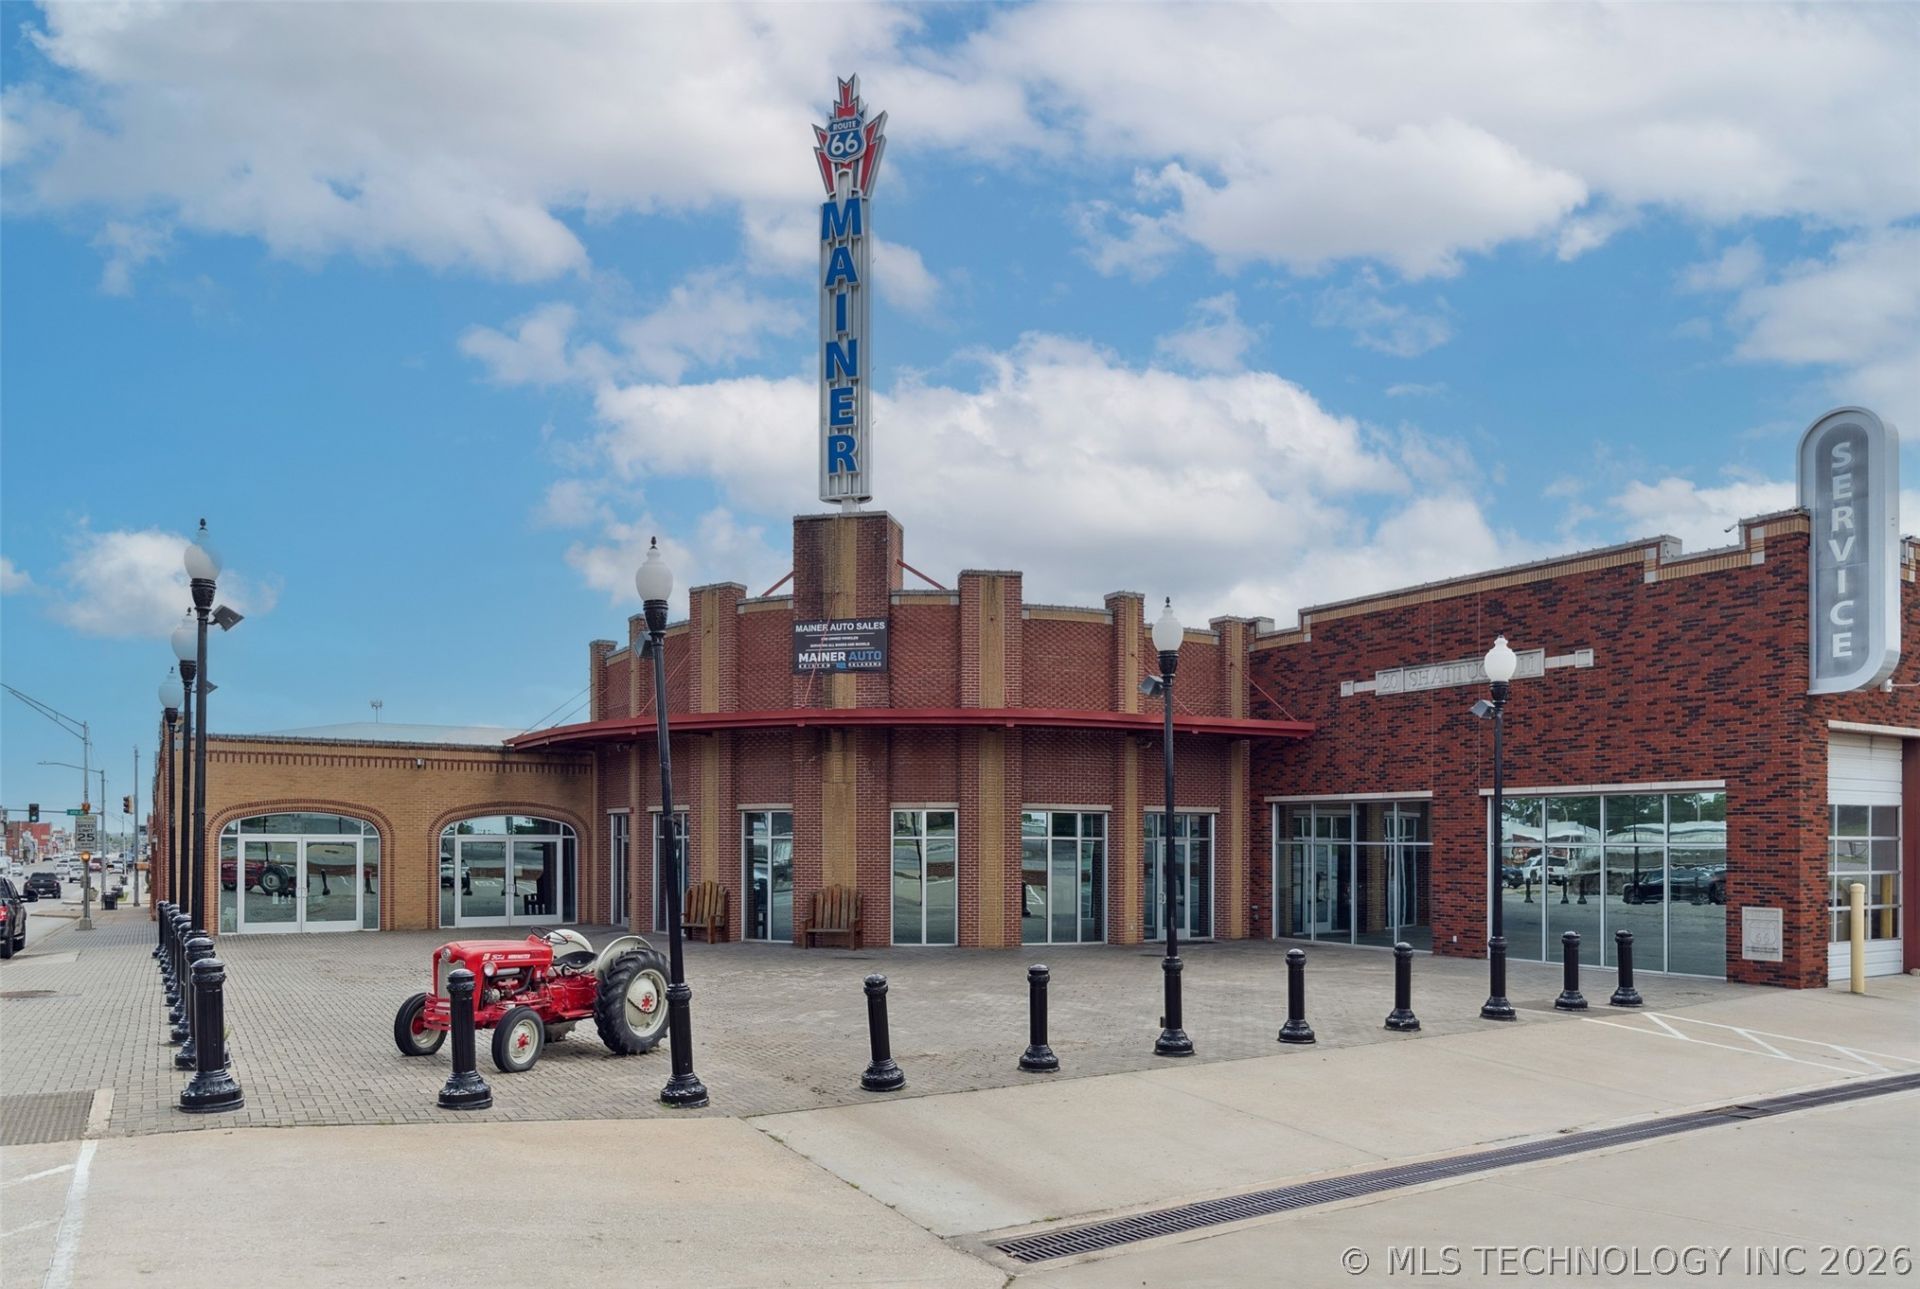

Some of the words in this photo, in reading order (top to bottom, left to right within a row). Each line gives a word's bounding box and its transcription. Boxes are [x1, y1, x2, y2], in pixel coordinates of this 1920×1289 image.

[833, 120, 857, 131] ROUTE
[831, 132, 859, 156] 66
[821, 197, 862, 475] MAINER
[1828, 441, 1856, 658] SERVICE
[795, 624, 829, 633] MAINER
[829, 622, 855, 631] AUTO
[856, 621, 886, 630] SALES
[798, 651, 846, 663] MAINER
[848, 650, 882, 661] AUTO
[1408, 662, 1488, 687] SHATTUC
[77, 833, 95, 842] 25
